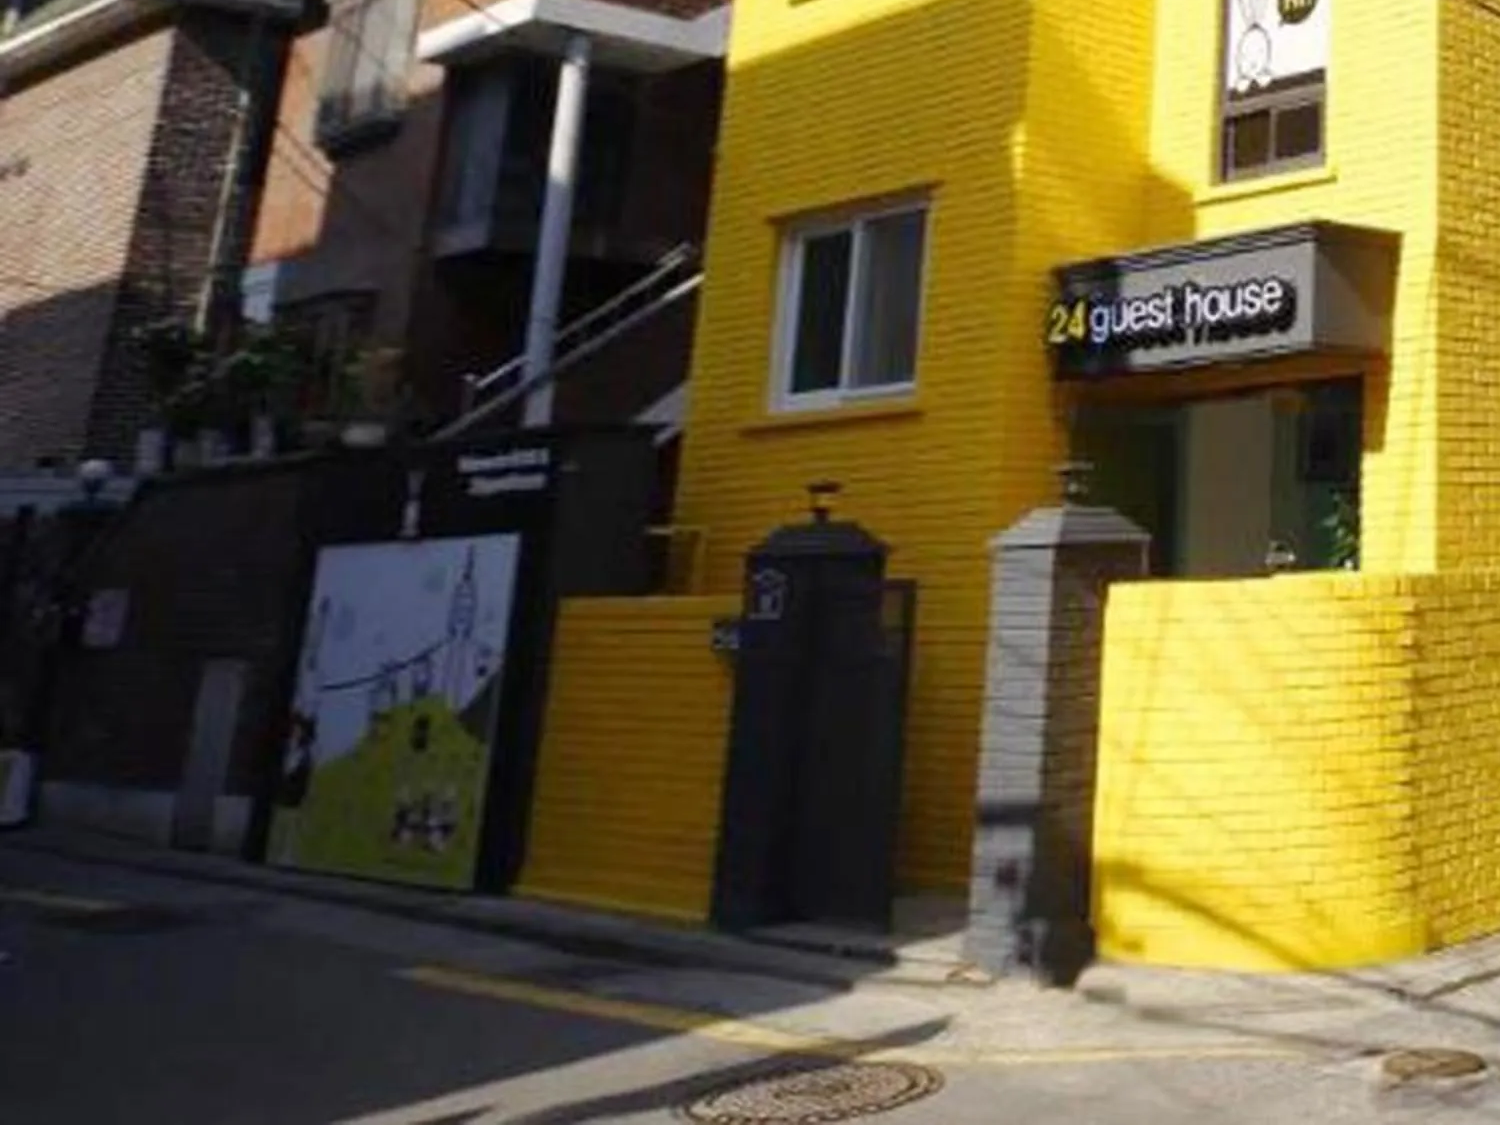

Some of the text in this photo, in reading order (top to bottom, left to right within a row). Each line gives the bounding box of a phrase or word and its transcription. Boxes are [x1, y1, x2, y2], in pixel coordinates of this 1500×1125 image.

[1048, 279, 1284, 344] 24 guest house
